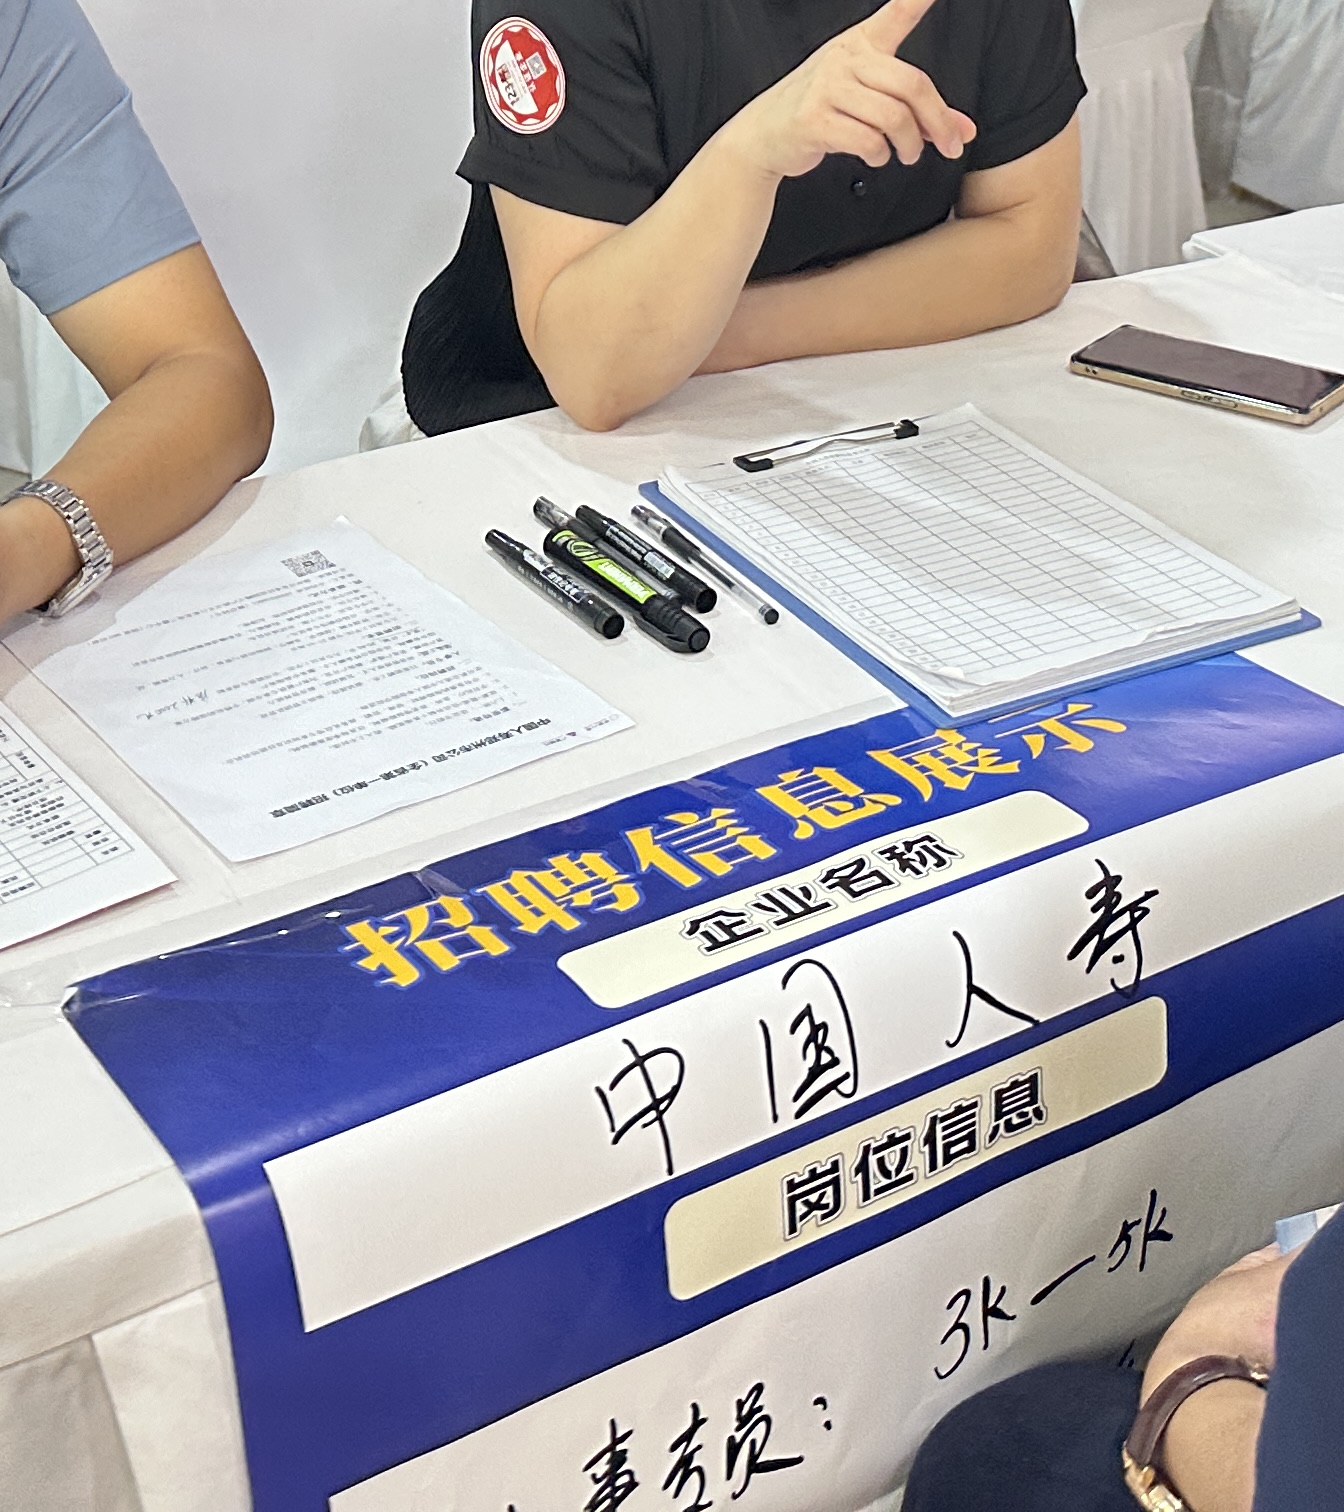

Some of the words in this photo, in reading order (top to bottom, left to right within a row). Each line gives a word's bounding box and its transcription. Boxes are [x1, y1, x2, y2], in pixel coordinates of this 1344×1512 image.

[339, 702, 1128, 987] 招聘信息展示
[684, 833, 962, 952] 企业名称
[594, 858, 1160, 1177] 中国人寿
[785, 1070, 1047, 1238] 岗位信息
[502, 1382, 833, 1512] 事专员：
